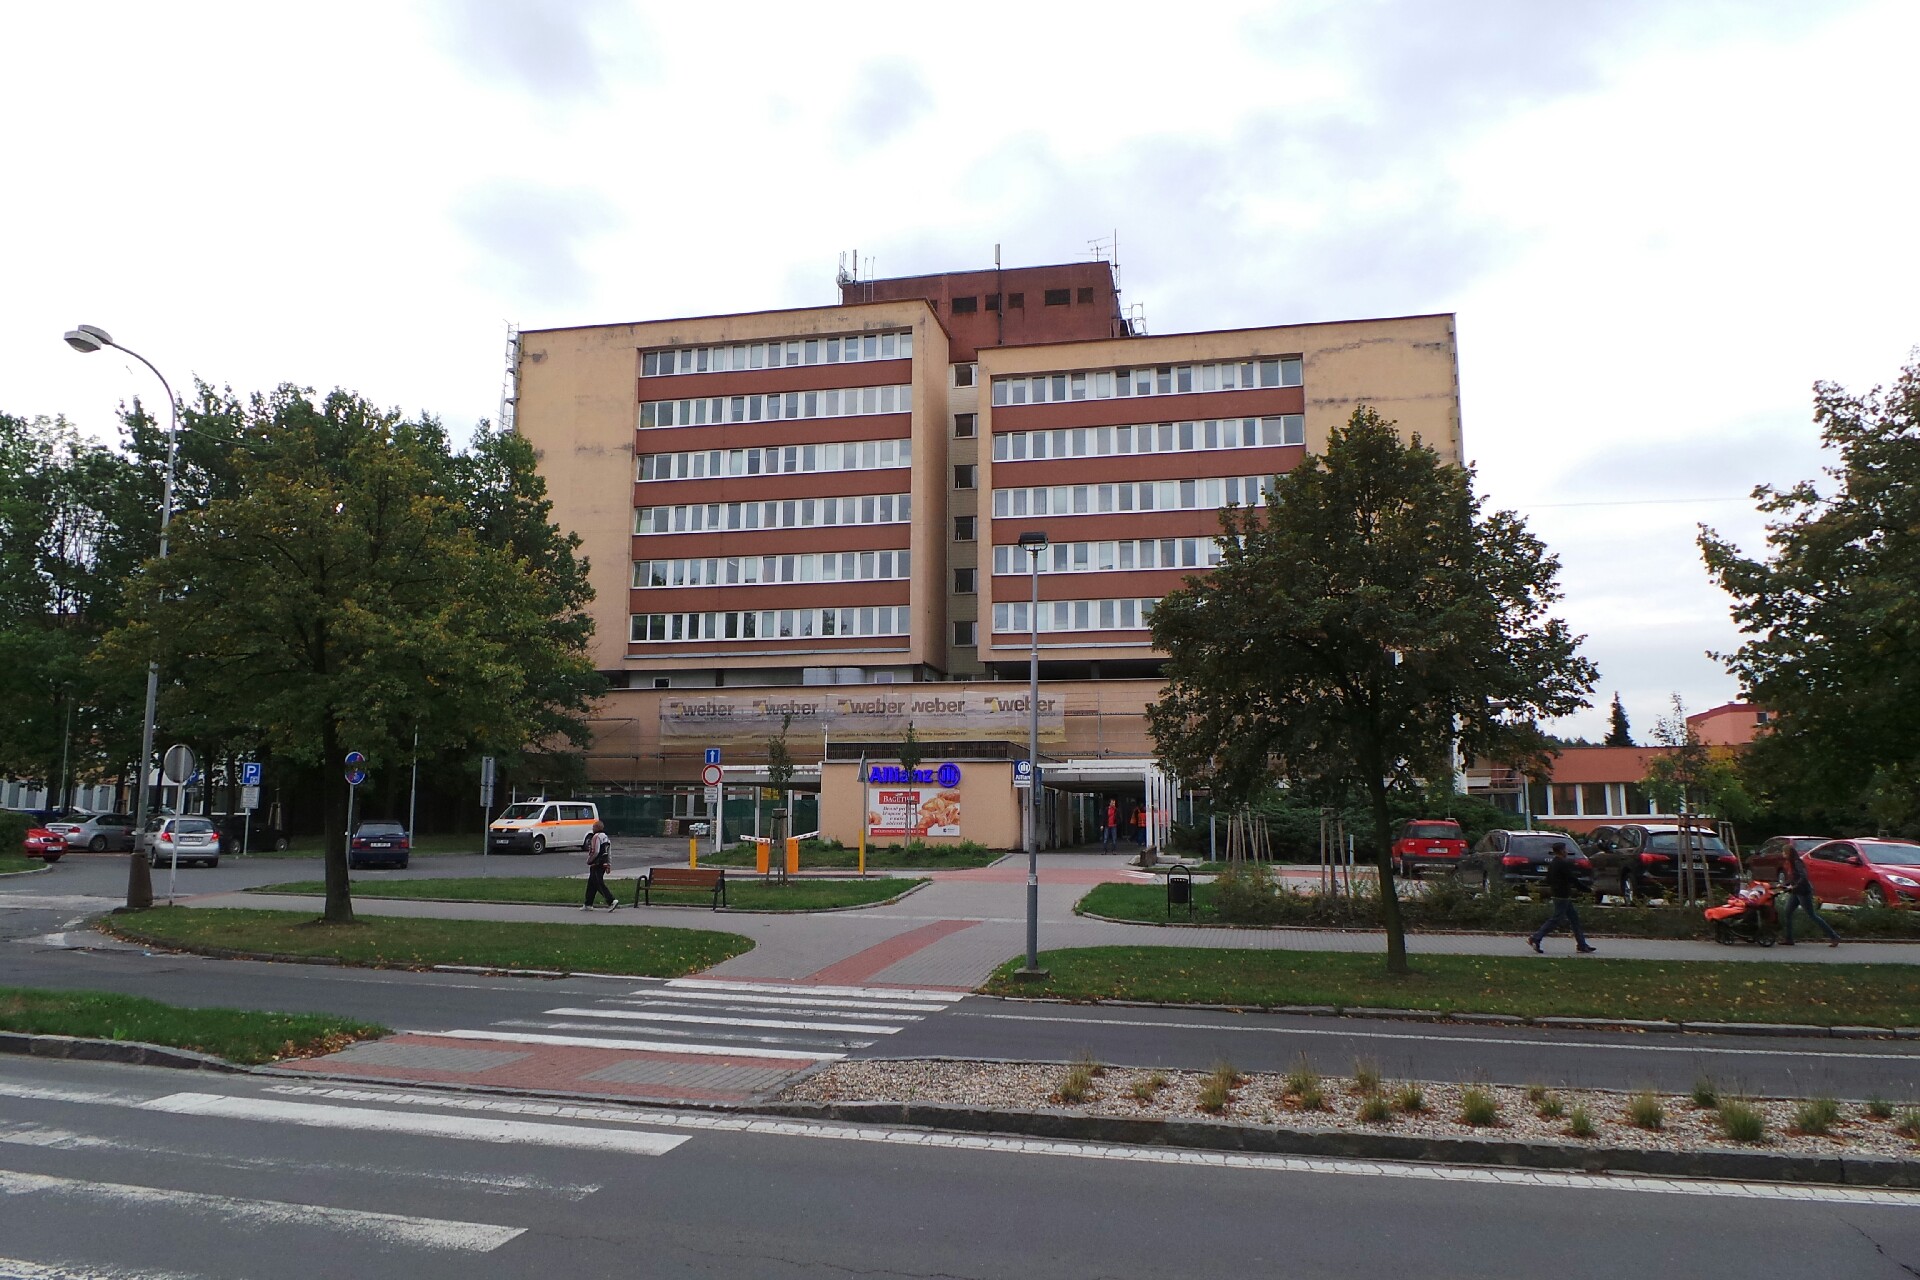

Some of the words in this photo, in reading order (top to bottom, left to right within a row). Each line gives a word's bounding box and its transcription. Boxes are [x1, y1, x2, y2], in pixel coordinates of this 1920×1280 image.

[683, 701, 735, 717] weber
[765, 700, 819, 716] weber
[851, 698, 905, 714] weber
[911, 697, 965, 713] weber
[246, 765, 256, 778] P
[869, 766, 934, 784] Allianz
